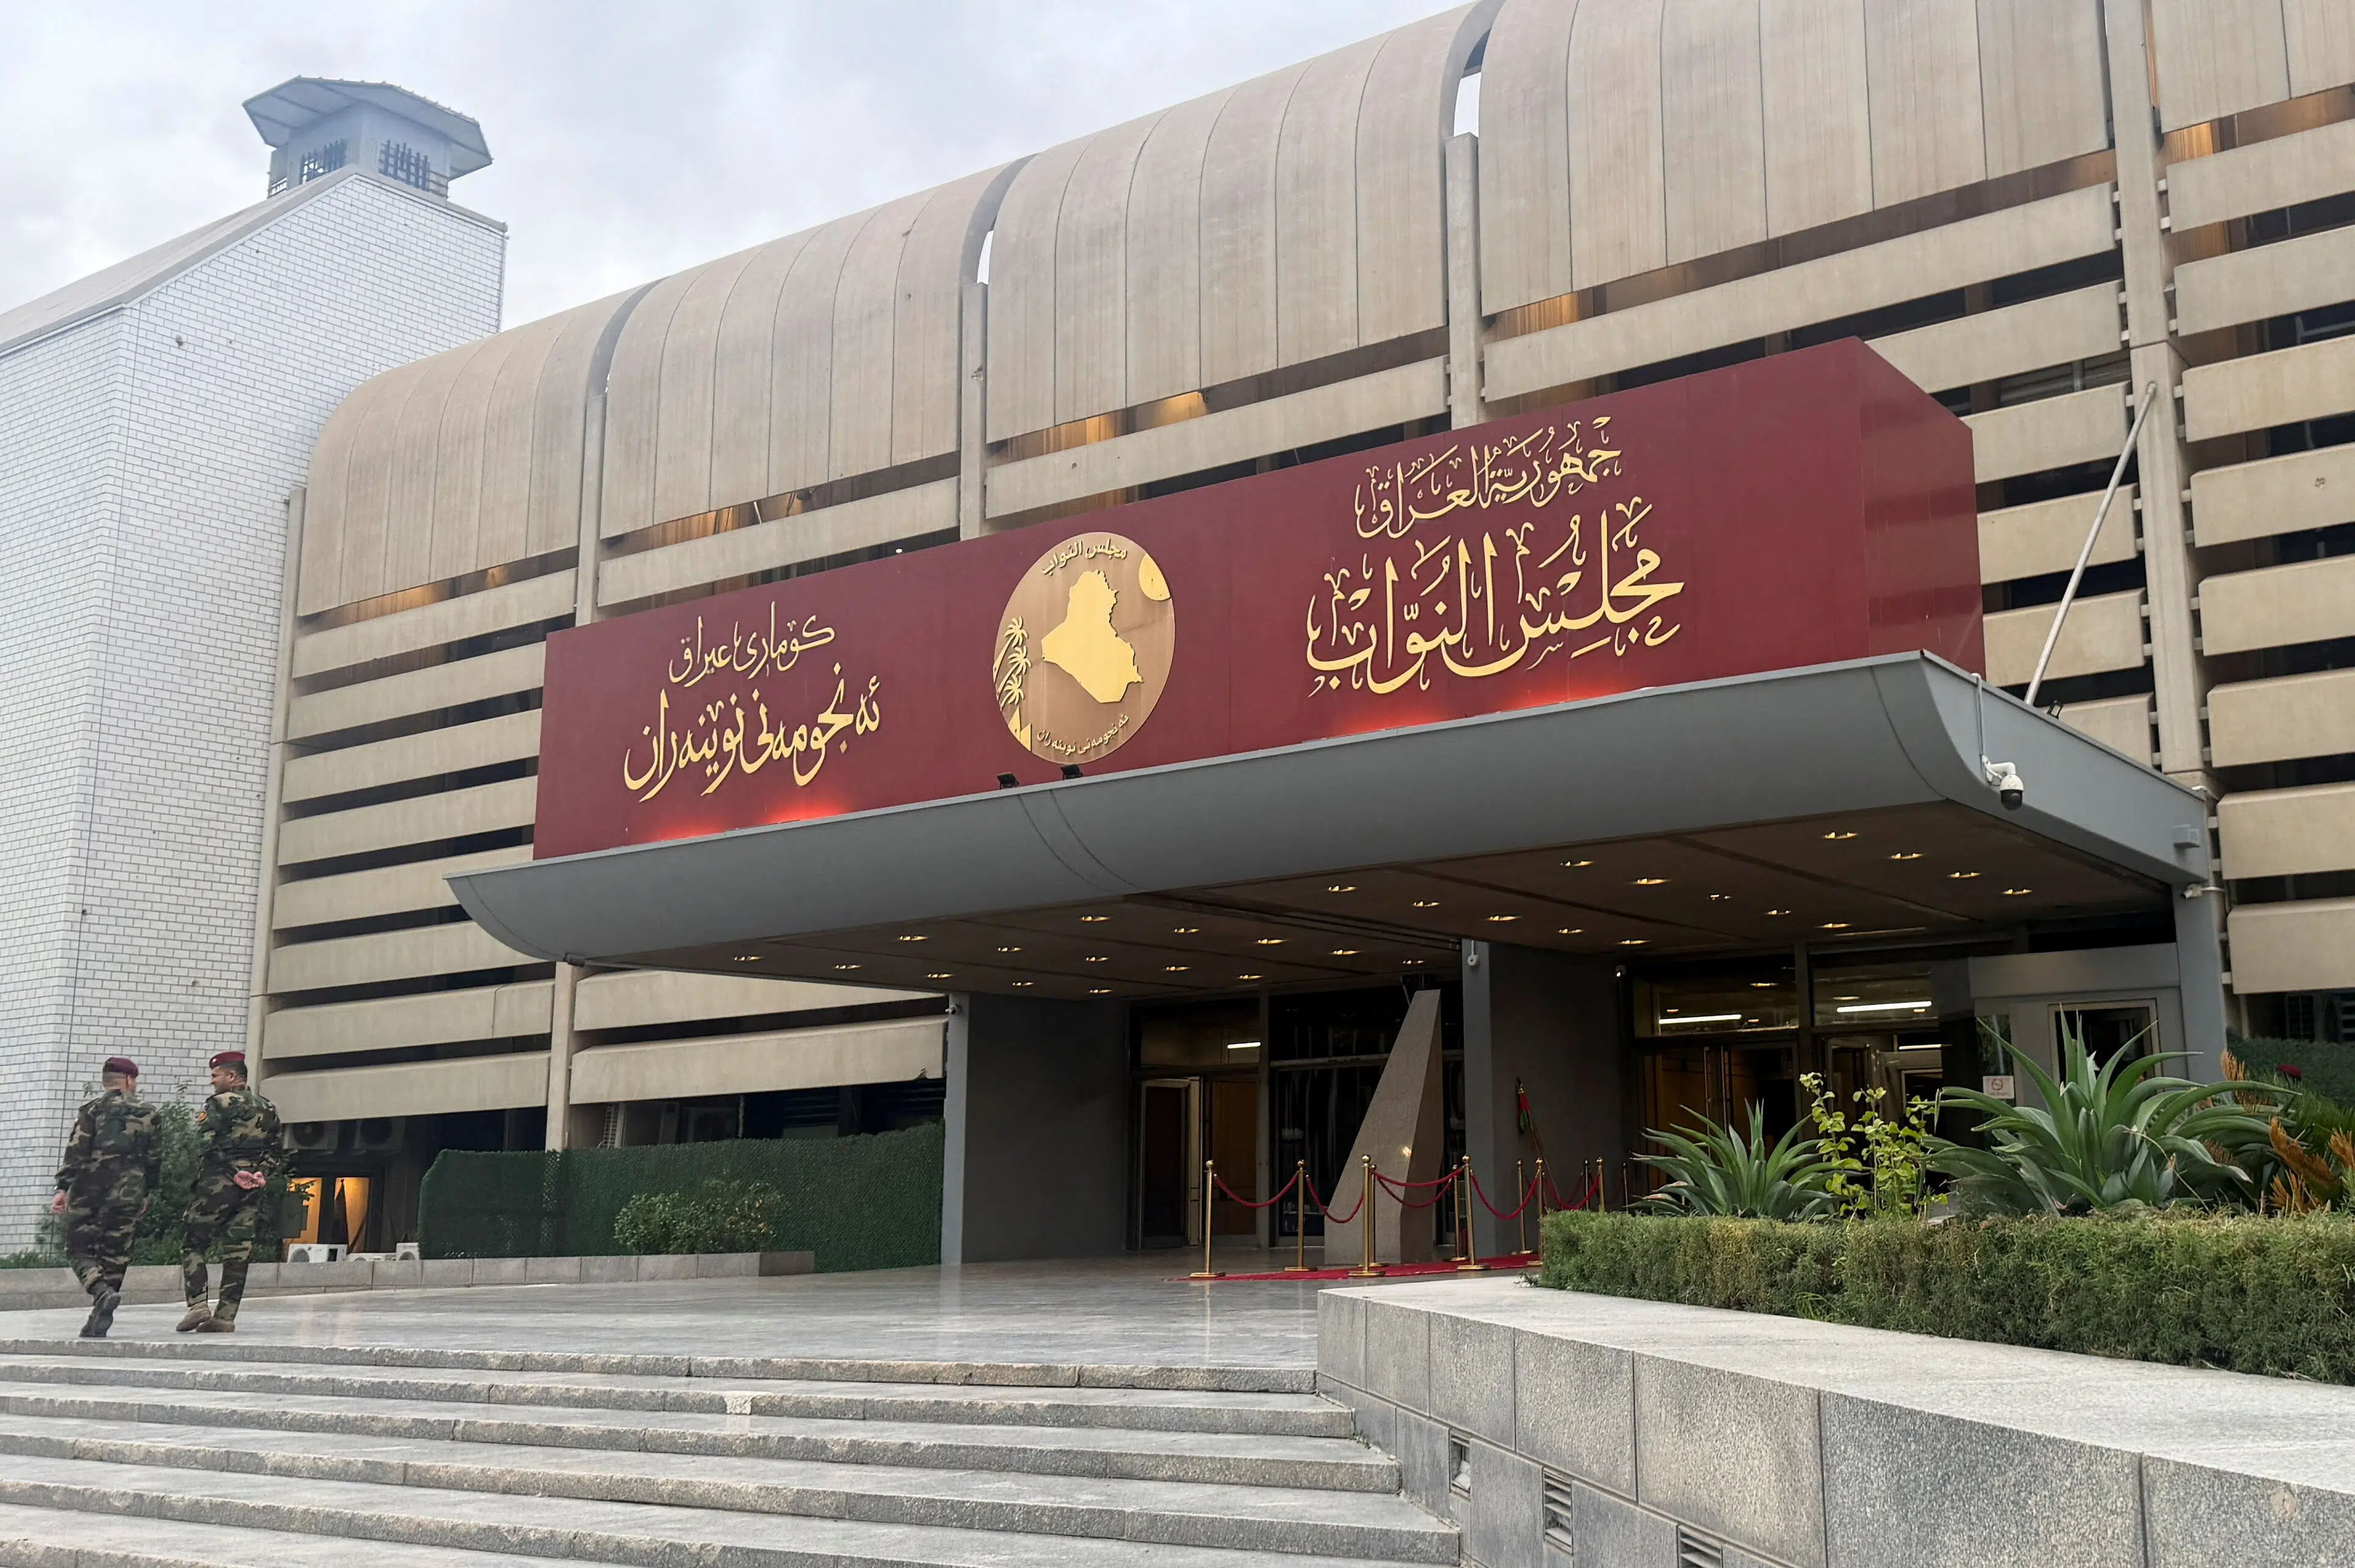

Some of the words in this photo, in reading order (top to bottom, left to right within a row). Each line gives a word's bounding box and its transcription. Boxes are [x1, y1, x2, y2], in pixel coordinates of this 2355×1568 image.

[1355, 444, 1494, 540] العراق
[1041, 540, 1083, 576] النواب
[1085, 538, 1127, 560] مجلس
